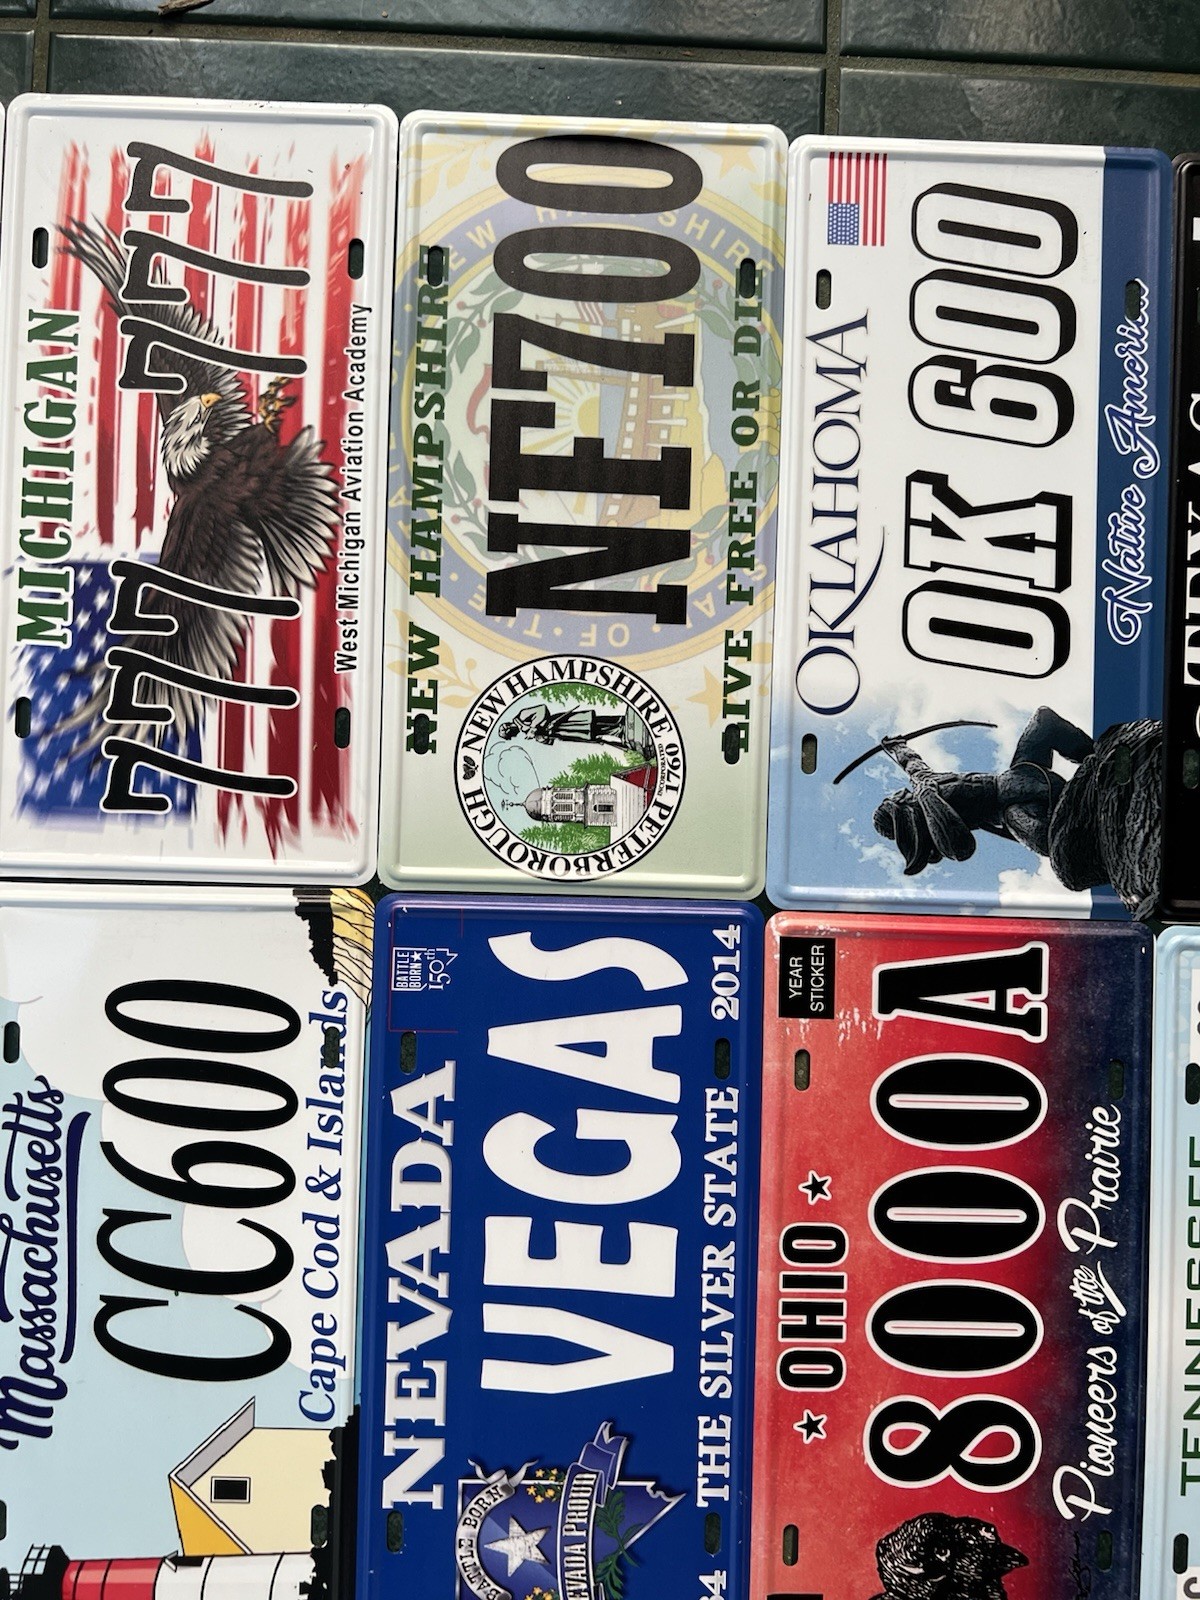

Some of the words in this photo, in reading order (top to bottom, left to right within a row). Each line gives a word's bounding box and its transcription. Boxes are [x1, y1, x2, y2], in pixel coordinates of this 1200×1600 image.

[117, 141, 314, 394] 777
[908, 182, 1078, 448] 600
[343, 303, 372, 402] Academy
[485, 135, 703, 625] NF700
[340, 411, 364, 502] Aviation
[730, 379, 760, 447] OR
[16, 309, 80, 647] MICHIGAN
[795, 309, 886, 716] OKLAHOMA
[337, 511, 365, 610] Michigan
[725, 467, 757, 606] FREE
[901, 470, 1072, 679] OK
[1101, 484, 1153, 645] Native
[101, 560, 301, 814] 777
[335, 619, 358, 673] West
[461, 687, 508, 754] NEW
[502, 659, 673, 738] HAMPSHIRE
[657, 743, 667, 797] INCORPORATED
[665, 742, 681, 794] 1760
[462, 786, 675, 878] PETERBOROUGH
[395, 951, 410, 988] BATTLE
[409, 962, 422, 988] BORN
[710, 924, 741, 1022] 2014
[788, 956, 803, 999] YEAR
[809, 944, 825, 1013] STICKER
[93, 979, 301, 1383] CC600
[304, 1164, 342, 1200] &
[479, 932, 689, 1394] VEGAS
[703, 1086, 740, 1227] STATE
[1057, 1103, 1122, 1254] Prairie
[0, 1075, 67, 1451] Massachusetts
[302, 1211, 341, 1300] Cod
[862, 941, 1049, 1493] 8000A
[381, 1060, 456, 1510] NEVADA
[699, 1240, 737, 1400] SILVER
[776, 1222, 849, 1392] OHIO
[1069, 1263, 1108, 1309] the
[1078, 1310, 1118, 1335] of
[298, 1312, 346, 1422] Cape
[697, 1414, 732, 1508] THE
[1052, 1344, 1117, 1522] Pioneers
[462, 1484, 503, 1529] BORN
[562, 1472, 598, 1537] PROUD
[458, 1537, 501, 1600] BATTLE
